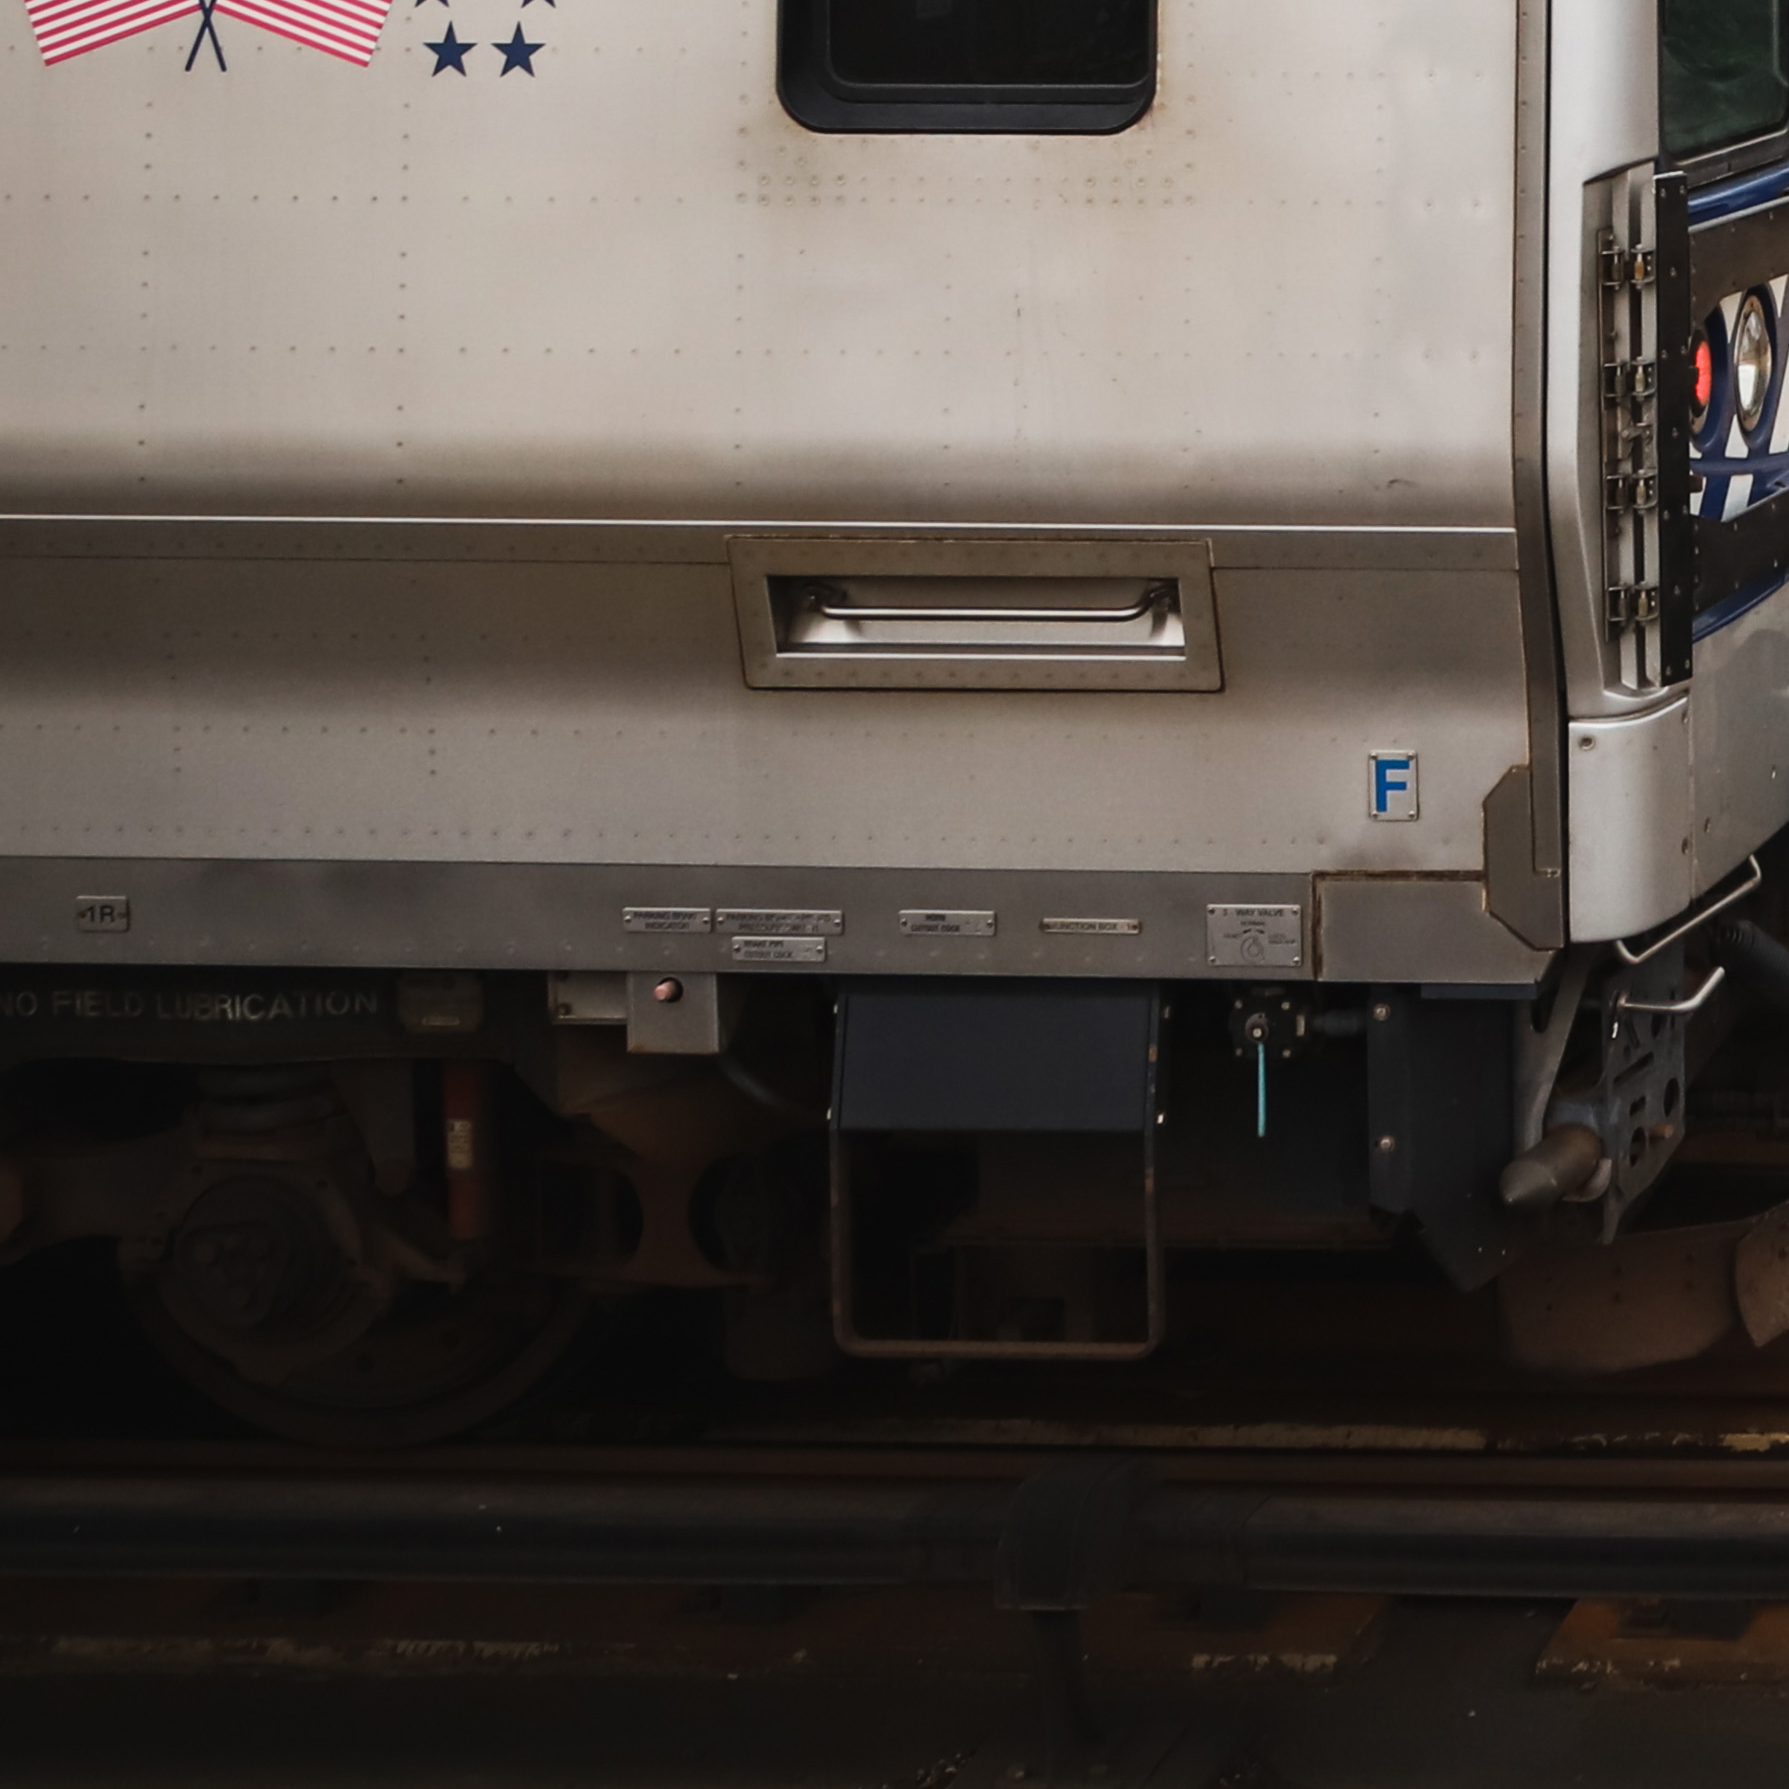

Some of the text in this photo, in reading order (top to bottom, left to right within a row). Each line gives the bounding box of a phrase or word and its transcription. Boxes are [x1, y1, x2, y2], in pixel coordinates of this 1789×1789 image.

[1374, 759, 1411, 813] F
[87, 904, 116, 924] 1R
[0, 989, 379, 1021] NO FIELD LUBRICATION
